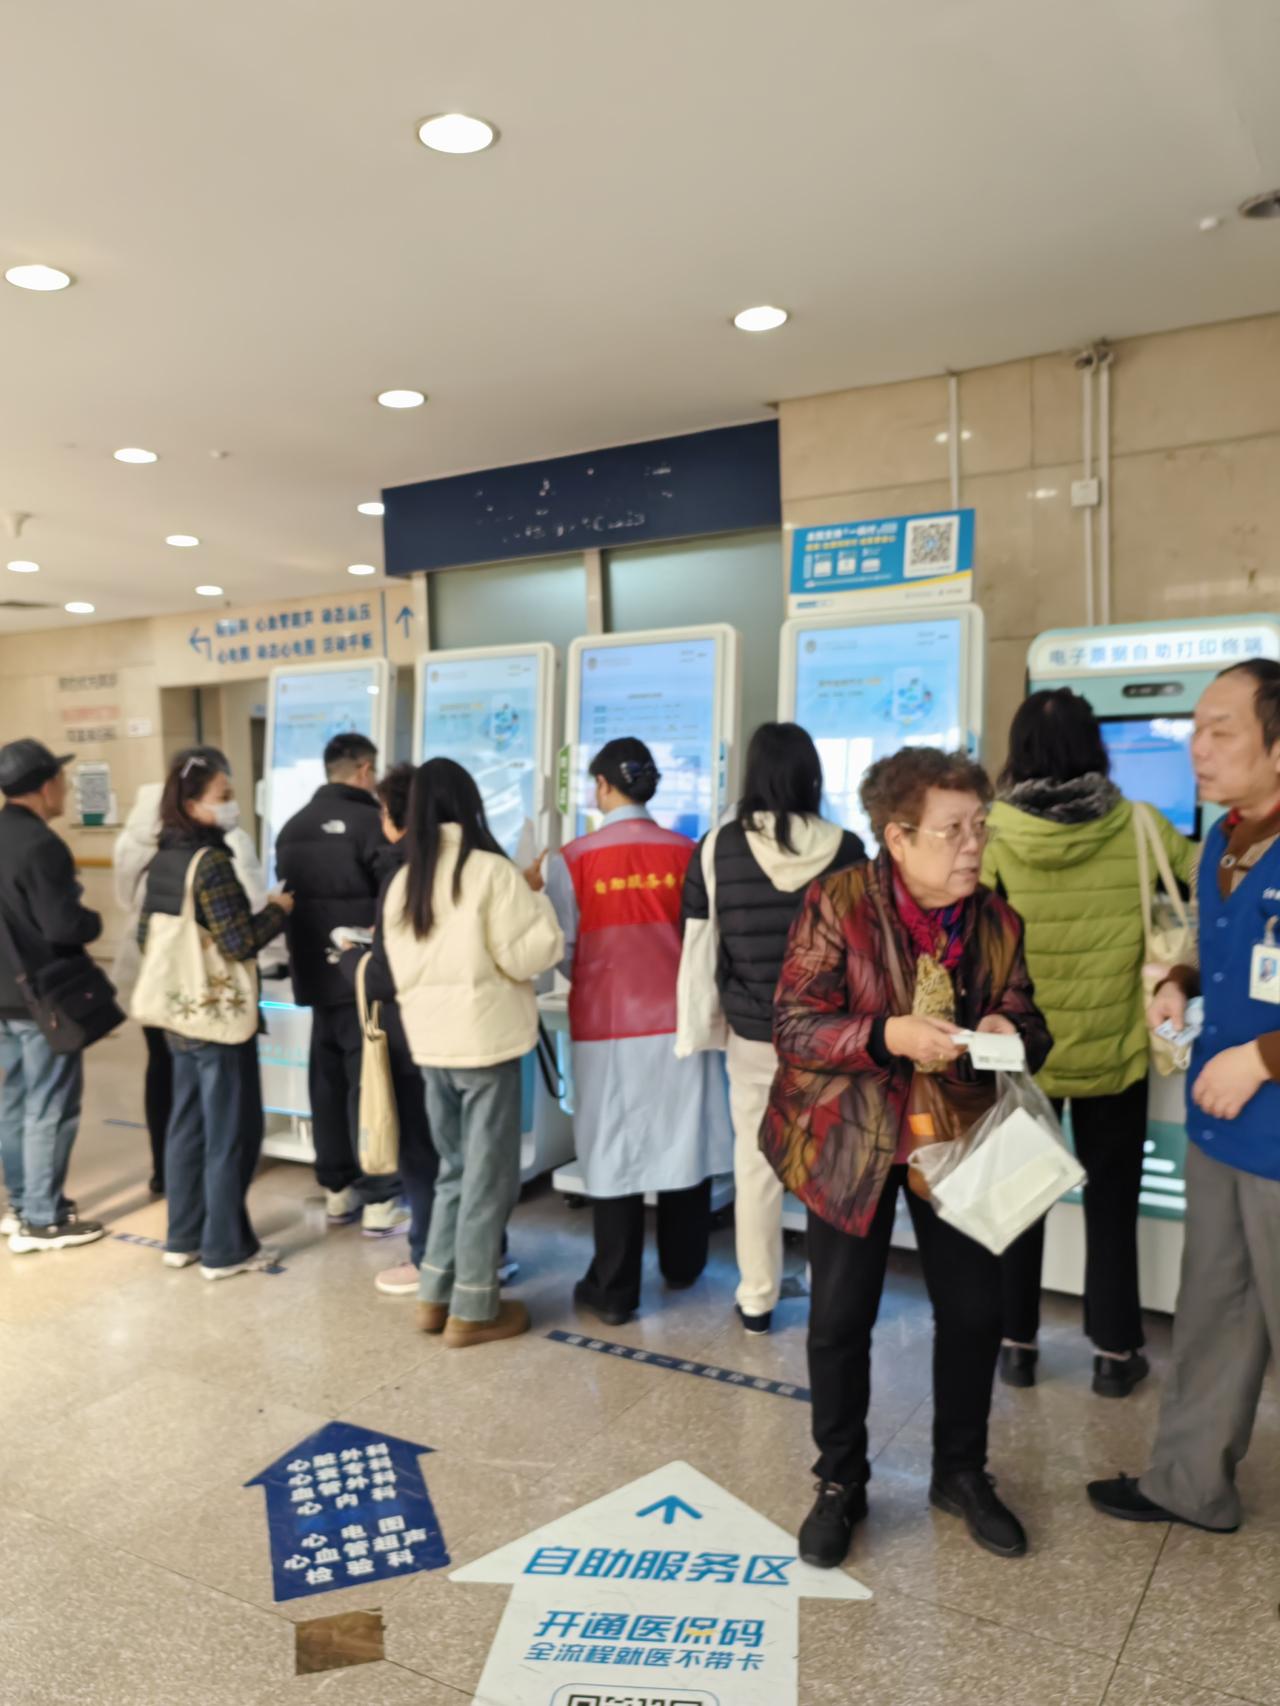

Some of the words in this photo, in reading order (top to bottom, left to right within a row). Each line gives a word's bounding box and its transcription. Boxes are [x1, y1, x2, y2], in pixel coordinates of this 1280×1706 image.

[1050, 637, 1262, 666] 电子票据自助打印终端
[286, 1442, 389, 1473] 心脏外科
[290, 1469, 397, 1503] 血管外科
[296, 1484, 396, 1517] 心内科
[301, 1515, 405, 1549] 心电图
[283, 1528, 427, 1571] 心血管超声
[523, 1545, 797, 1586] 自助服务区
[305, 1548, 414, 1586] 检验科
[533, 1610, 765, 1648] 开通医保码
[523, 1641, 764, 1672] 全流程就医不带卡
